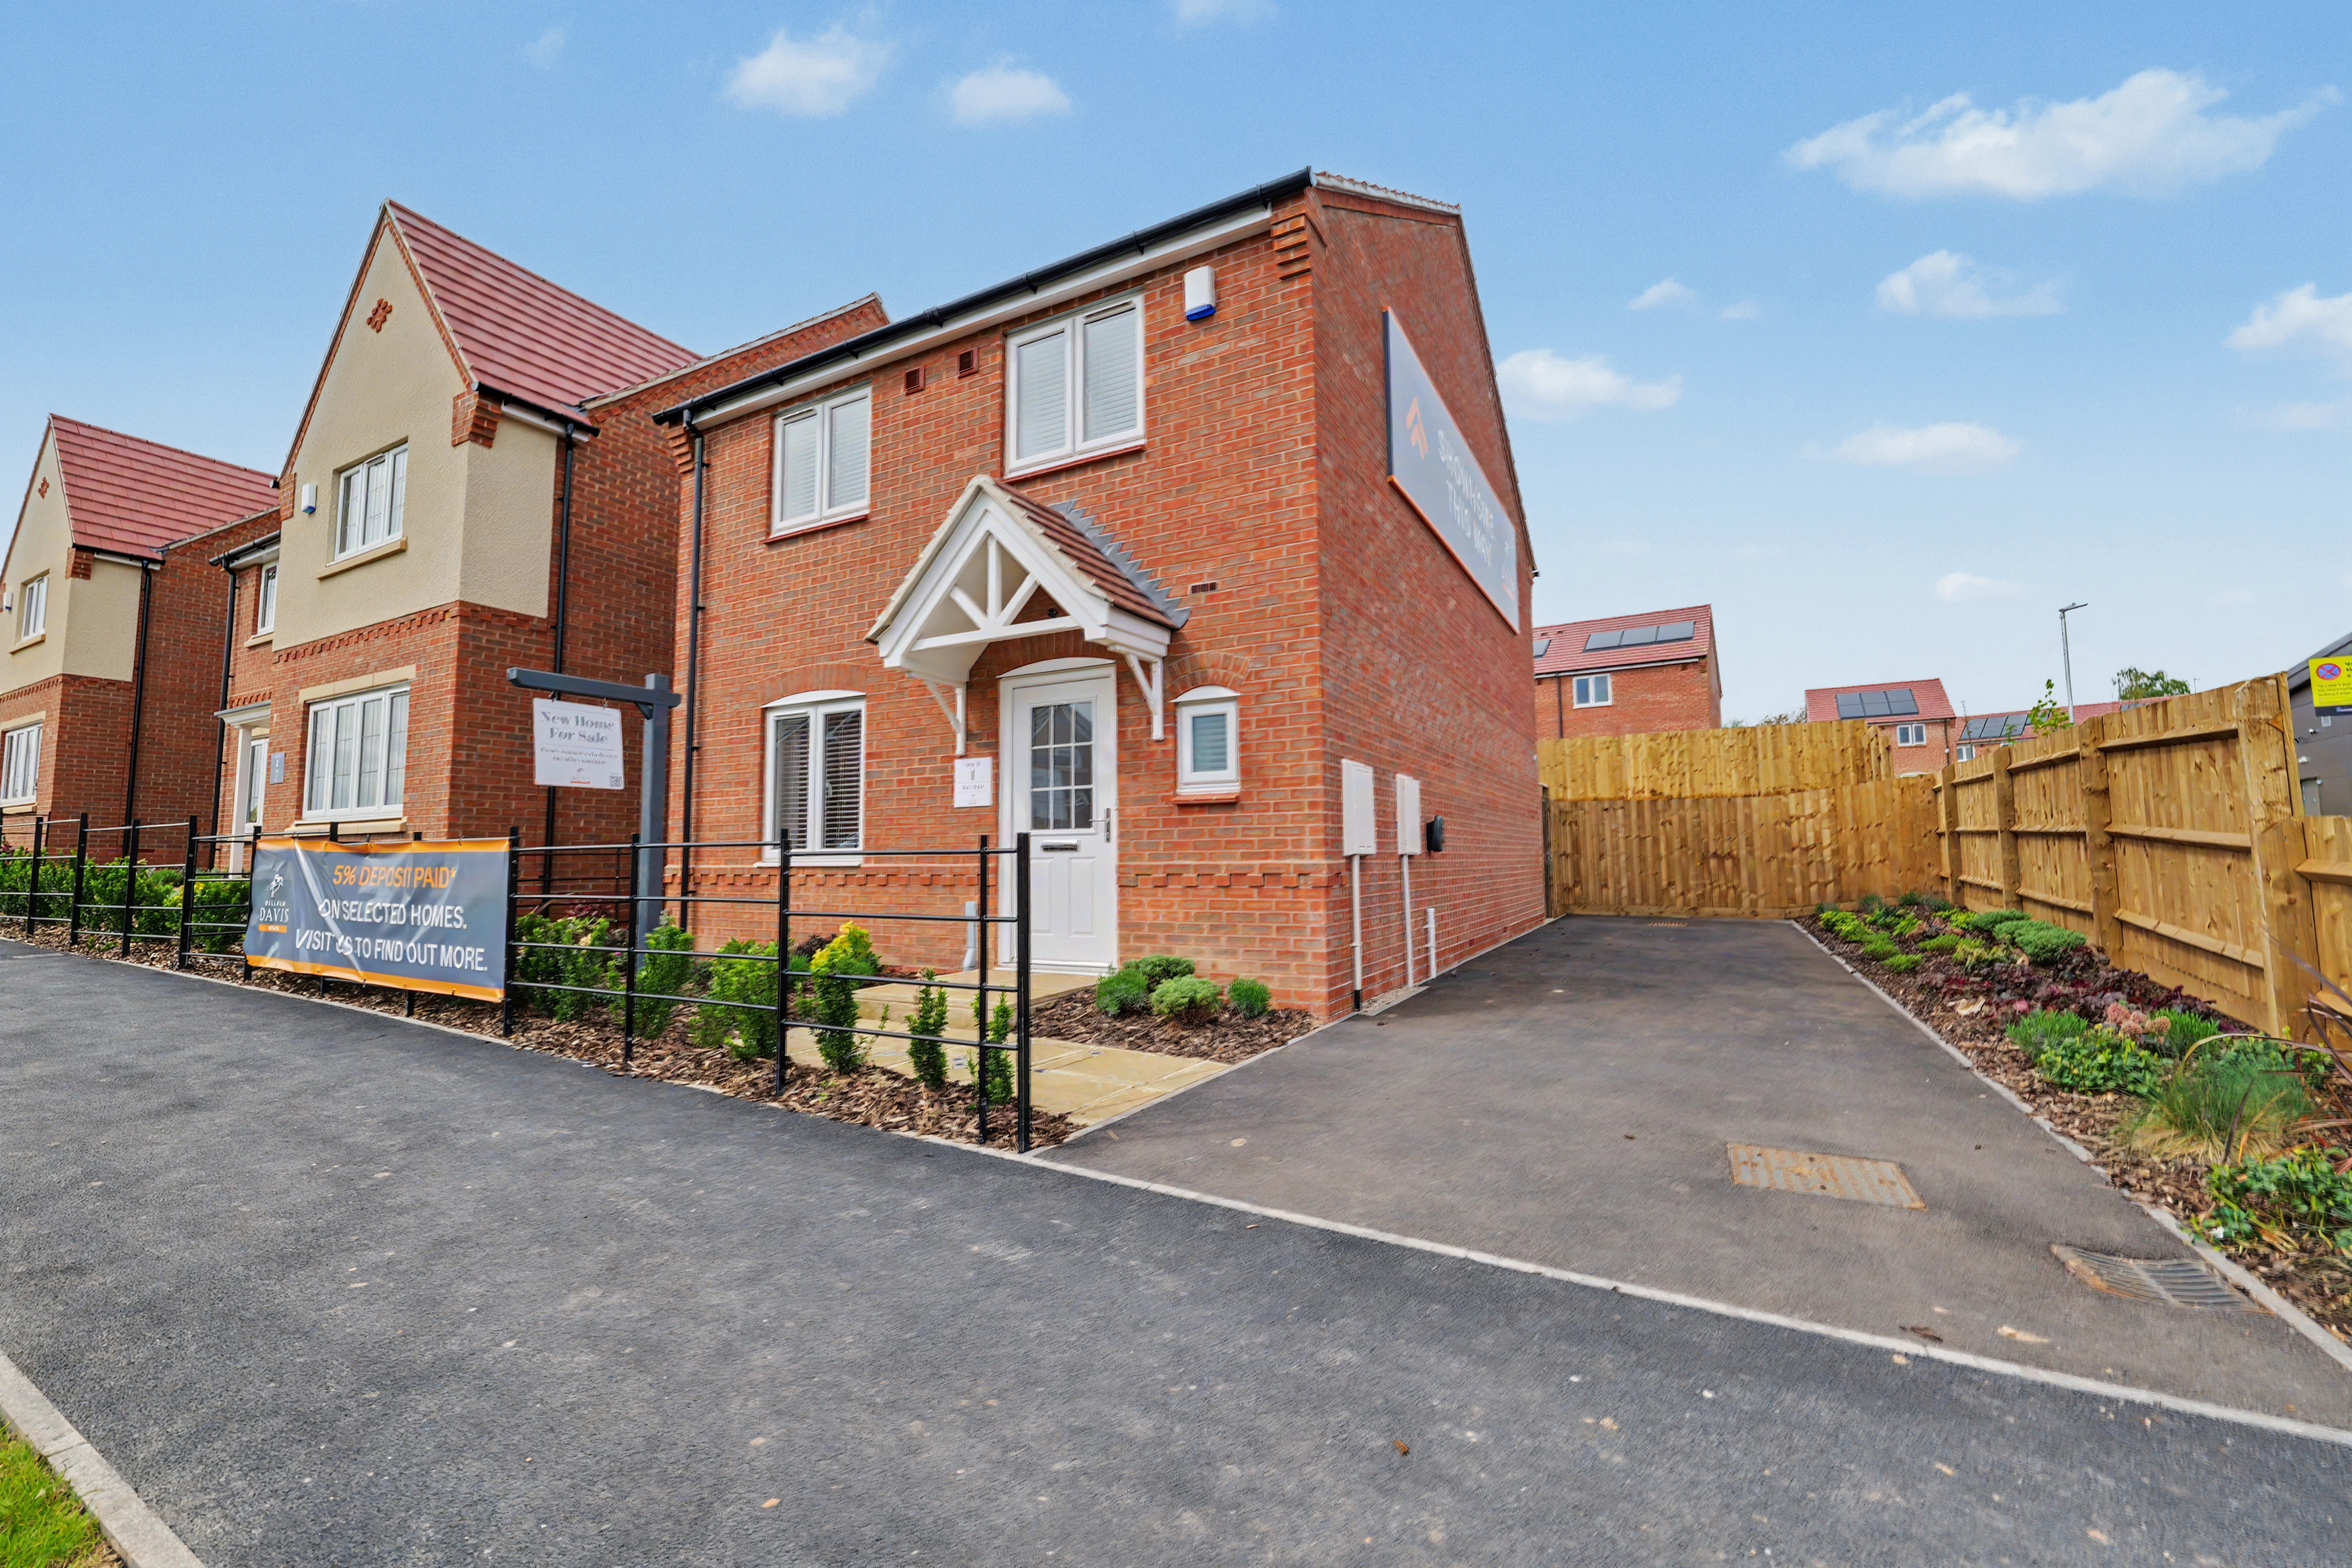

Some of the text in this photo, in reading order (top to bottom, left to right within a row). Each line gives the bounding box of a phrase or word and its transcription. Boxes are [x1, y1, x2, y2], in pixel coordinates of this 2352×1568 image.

[1446, 479, 1471, 538] THIS
[541, 711, 616, 730] New Home
[550, 727, 608, 744] For Sale
[333, 865, 356, 885] 5%
[359, 866, 412, 887] DEPOSIT
[260, 907, 289, 922] DAVIS
[318, 898, 467, 929] ON SELECTED HOMES.
[296, 929, 488, 971] VISIT US TO FIND OUT MORE.
